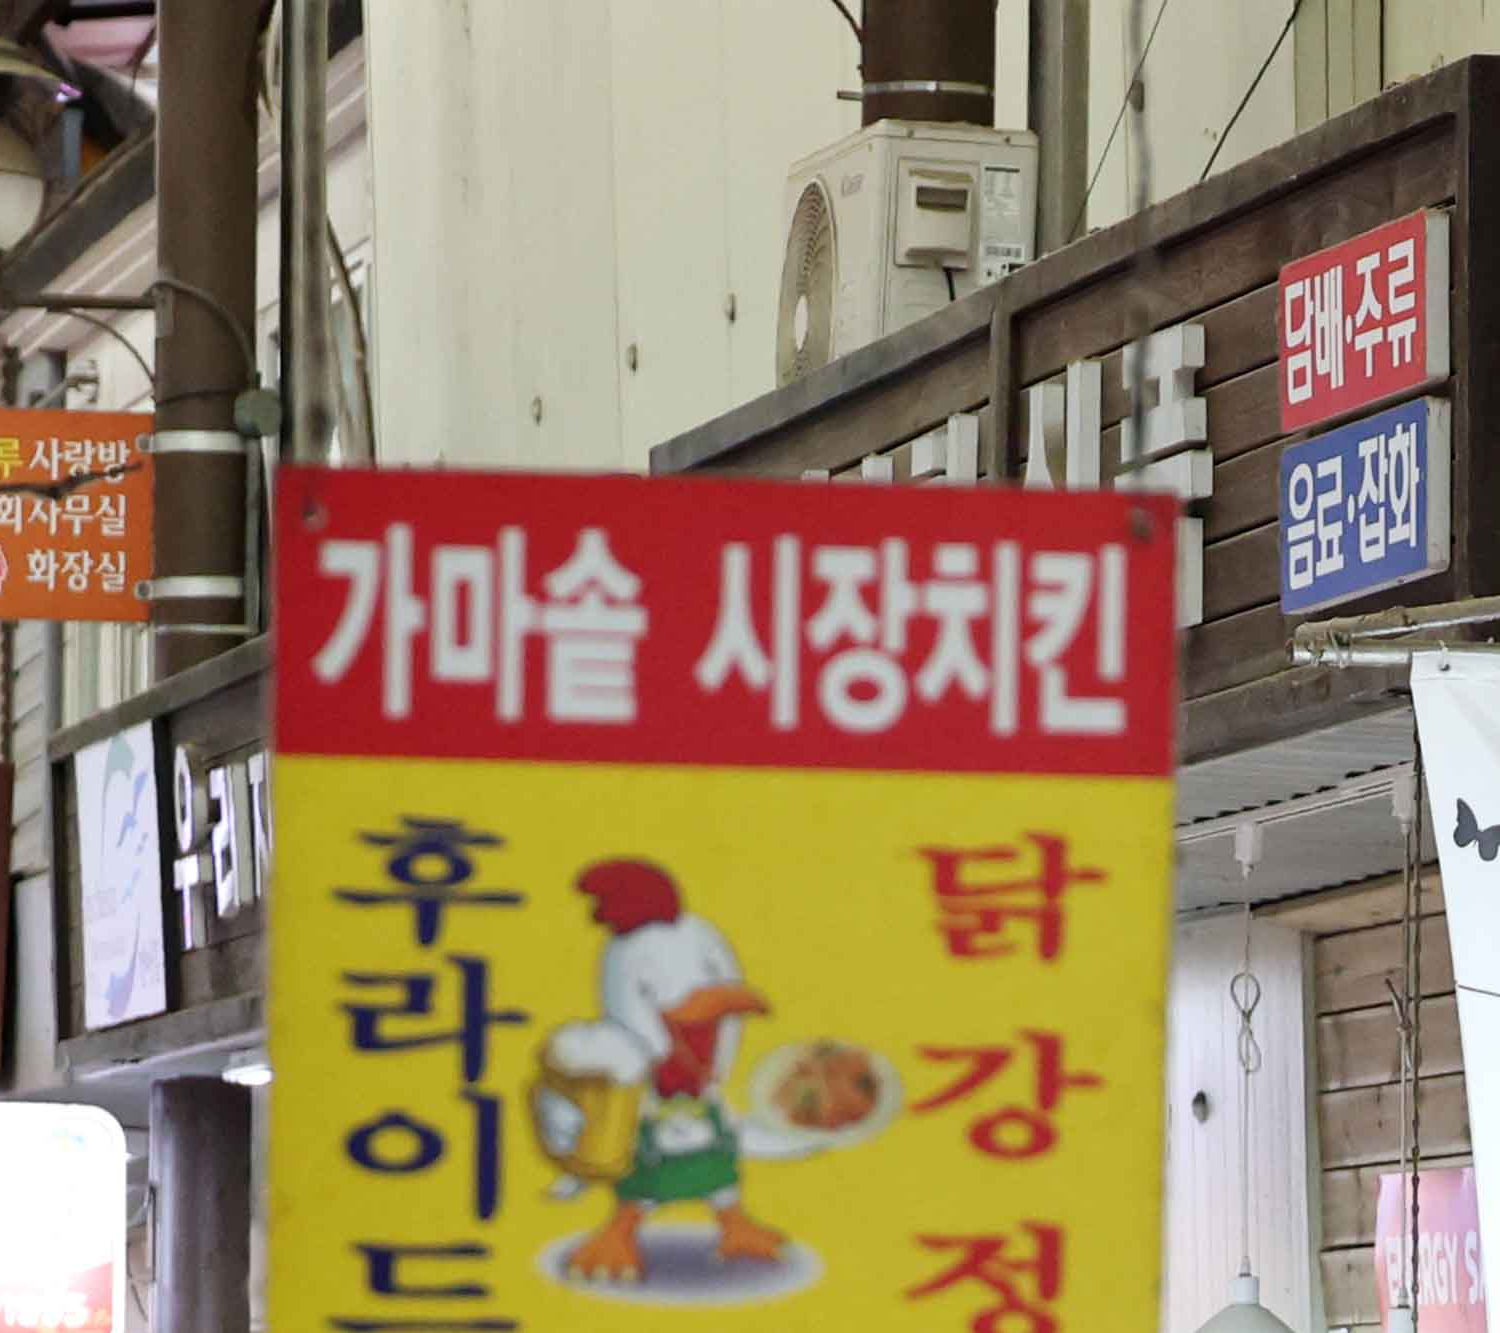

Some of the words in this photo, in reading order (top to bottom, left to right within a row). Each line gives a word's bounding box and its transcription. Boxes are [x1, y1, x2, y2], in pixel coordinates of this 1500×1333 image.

[28, 437, 132, 483] 사랑방
[26, 549, 128, 593] 화장실
[315, 522, 650, 723] 가마솥
[694, 533, 1130, 738] 시장치킨
